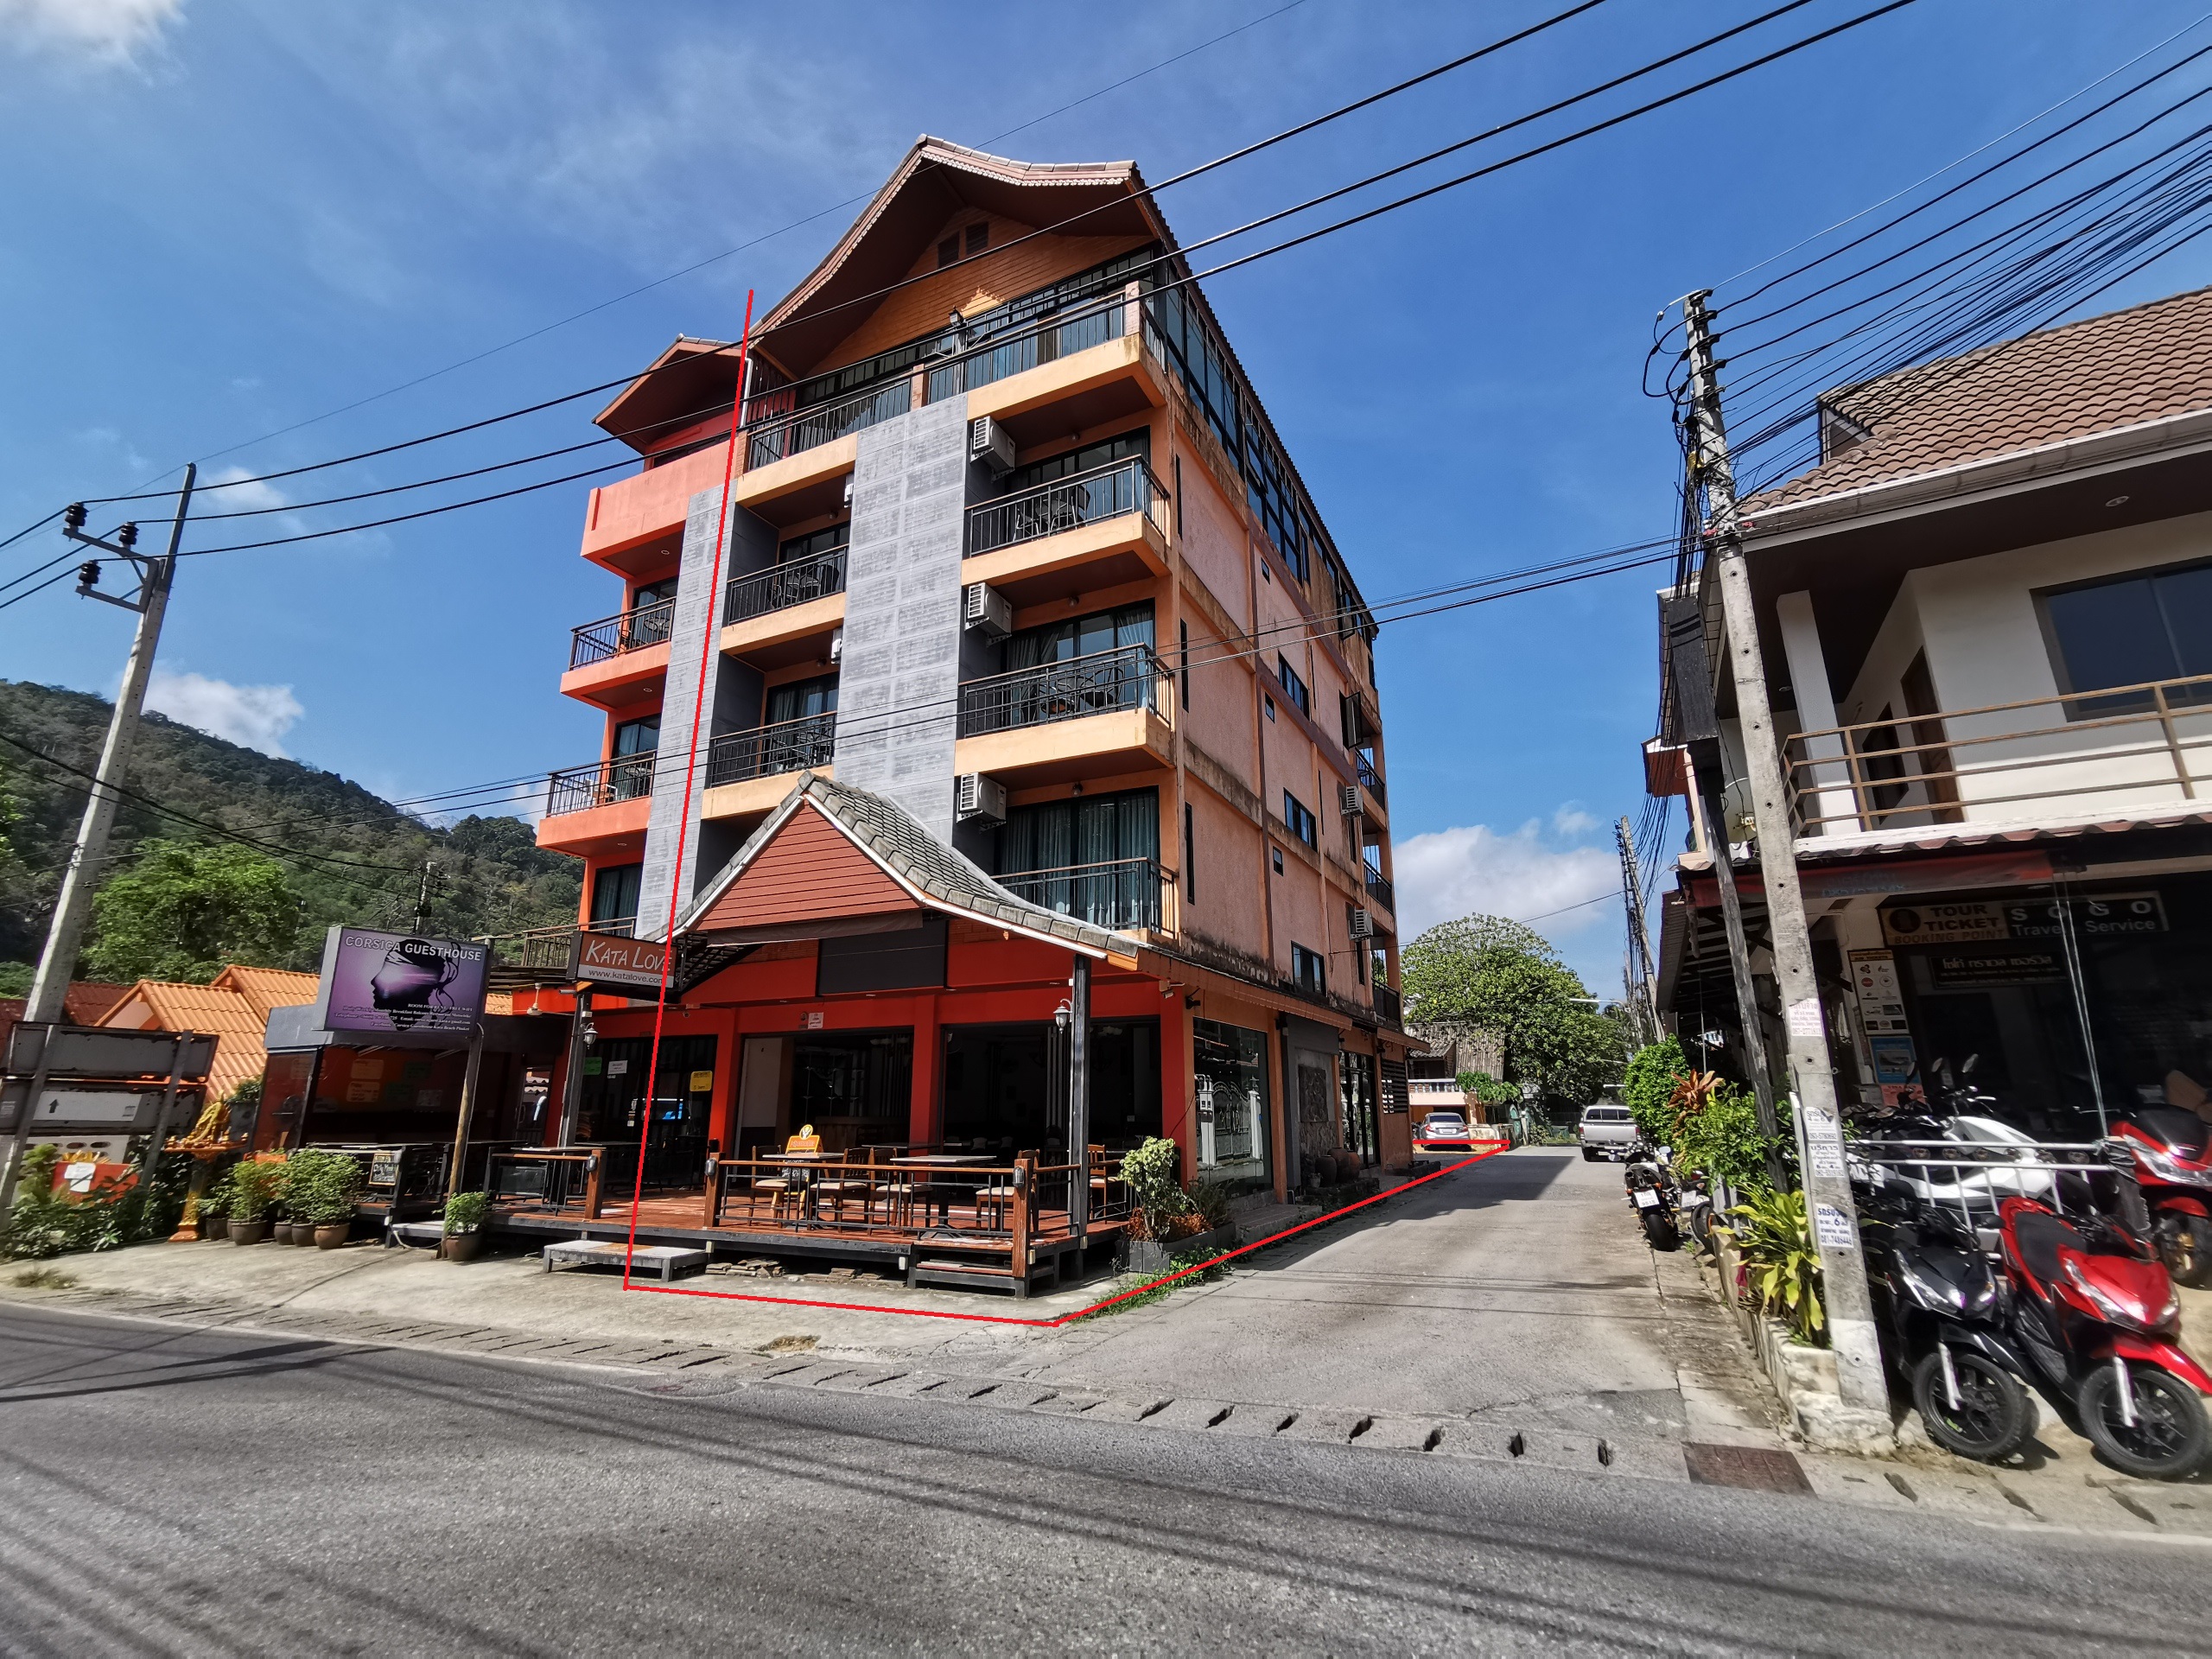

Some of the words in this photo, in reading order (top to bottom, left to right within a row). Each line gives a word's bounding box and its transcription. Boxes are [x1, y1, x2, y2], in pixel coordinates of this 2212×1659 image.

[1929, 904, 1987, 918] TOUR
[1923, 917, 1999, 931] TICKET
[2012, 923, 2064, 937] Trave
[2085, 918, 2157, 933] Service
[1894, 932, 1955, 944] BOOKING
[1962, 929, 2005, 941] POINT
[346, 936, 401, 952] CORSICA
[405, 943, 481, 961] GUESTHOUSE
[586, 940, 628, 966] KATA
